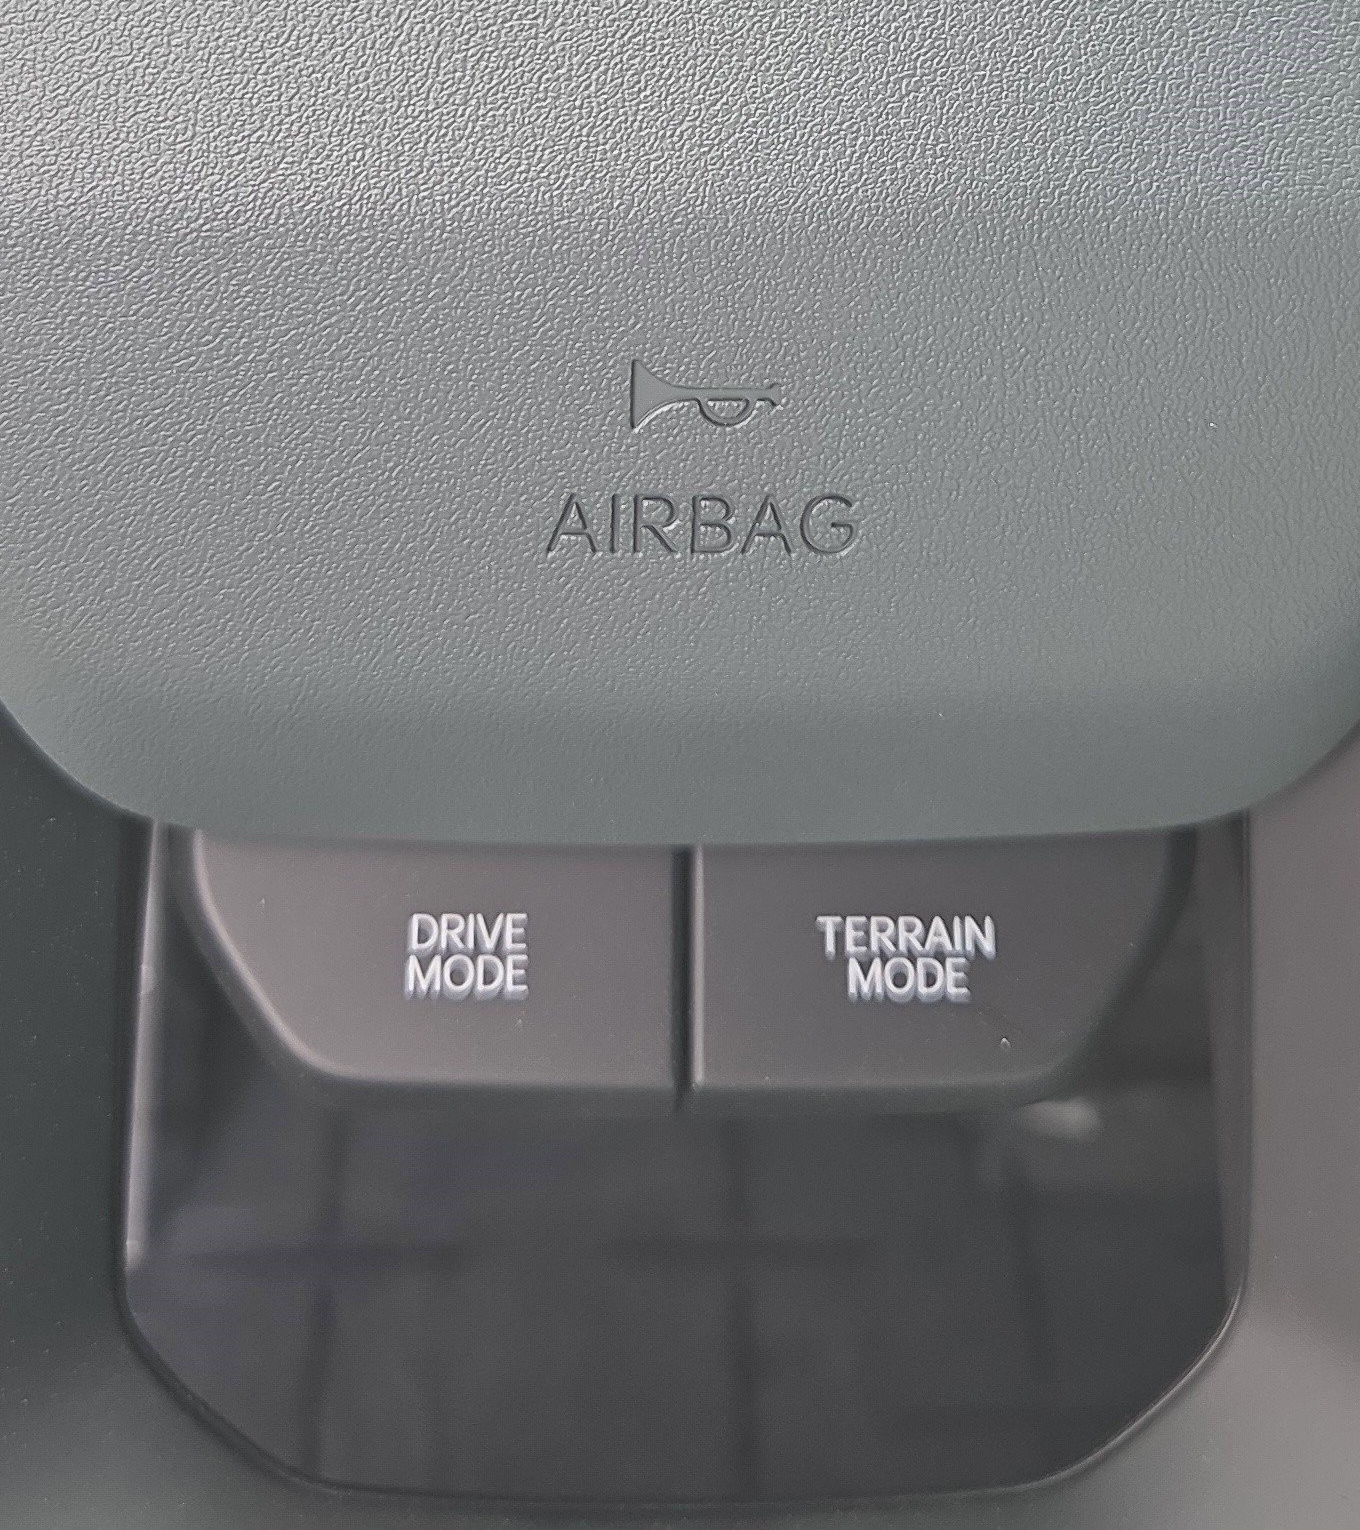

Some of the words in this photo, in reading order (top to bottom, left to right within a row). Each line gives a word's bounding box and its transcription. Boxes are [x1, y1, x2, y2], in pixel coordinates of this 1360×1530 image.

[546, 491, 858, 557] AIRBAG
[405, 913, 529, 953] DRIVE
[816, 915, 997, 958] TERRAIN
[405, 954, 529, 999] MODE
[846, 957, 971, 1001] MODE
